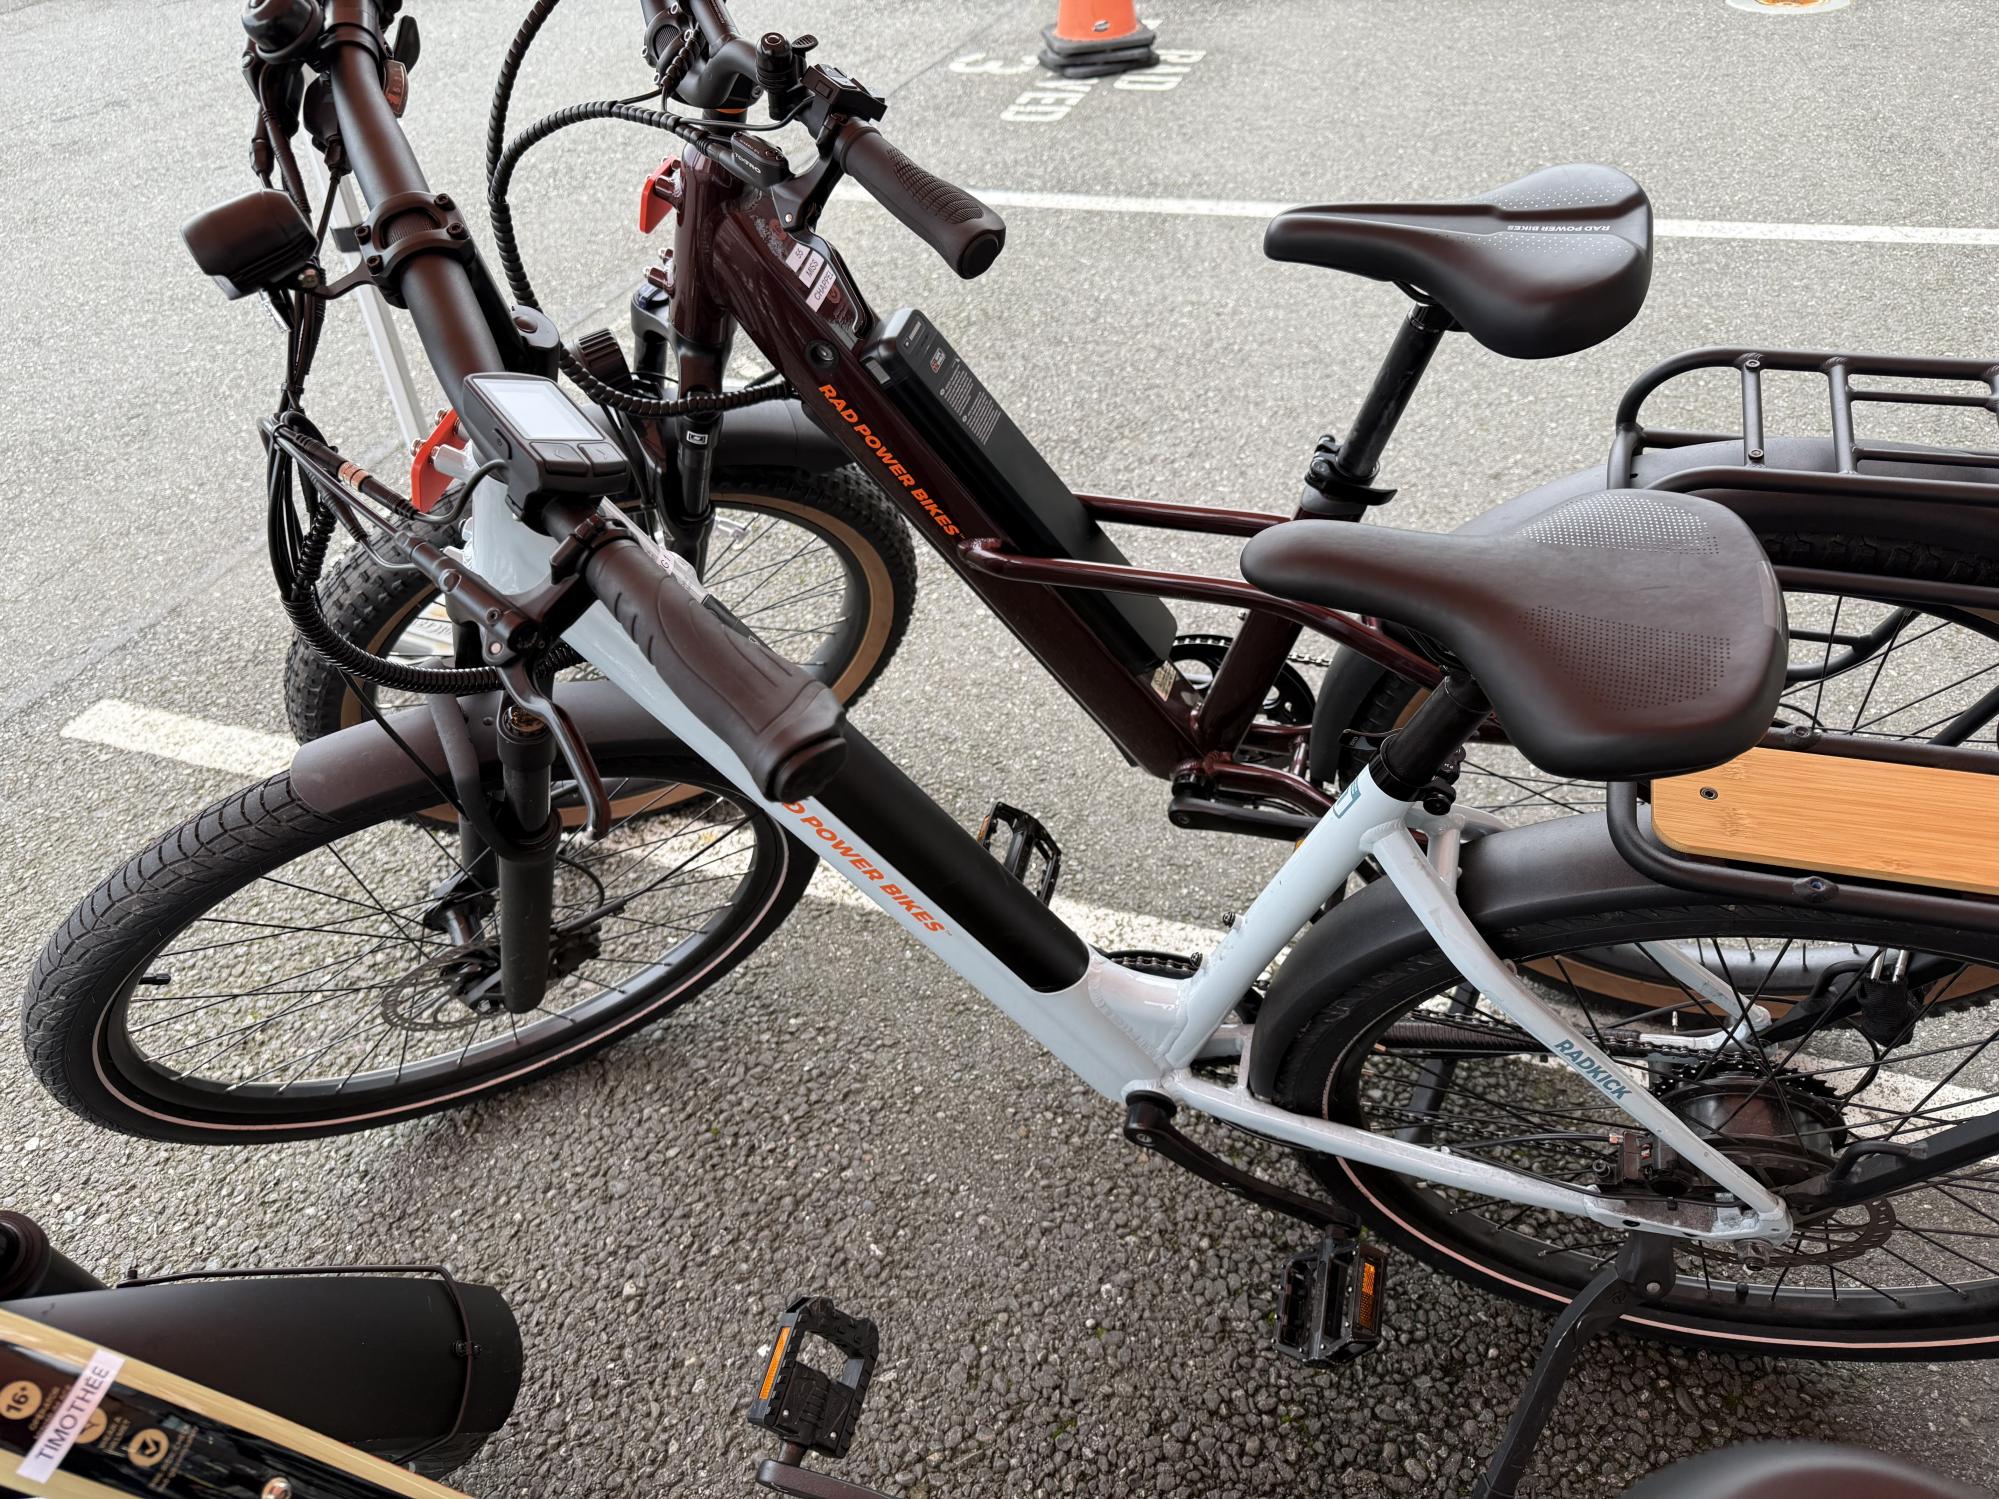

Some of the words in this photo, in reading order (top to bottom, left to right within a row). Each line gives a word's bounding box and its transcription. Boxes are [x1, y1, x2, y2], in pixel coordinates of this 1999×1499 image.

[806, 259, 819, 279] MISS
[818, 384, 858, 423] RAD
[854, 423, 915, 487] POWER
[911, 488, 960, 535] BIKES
[800, 815, 885, 881] POWER
[879, 883, 946, 933] BIKES
[1554, 1038, 1633, 1100] RADKICK
[35, 1365, 110, 1460] TIMOTHÉE
